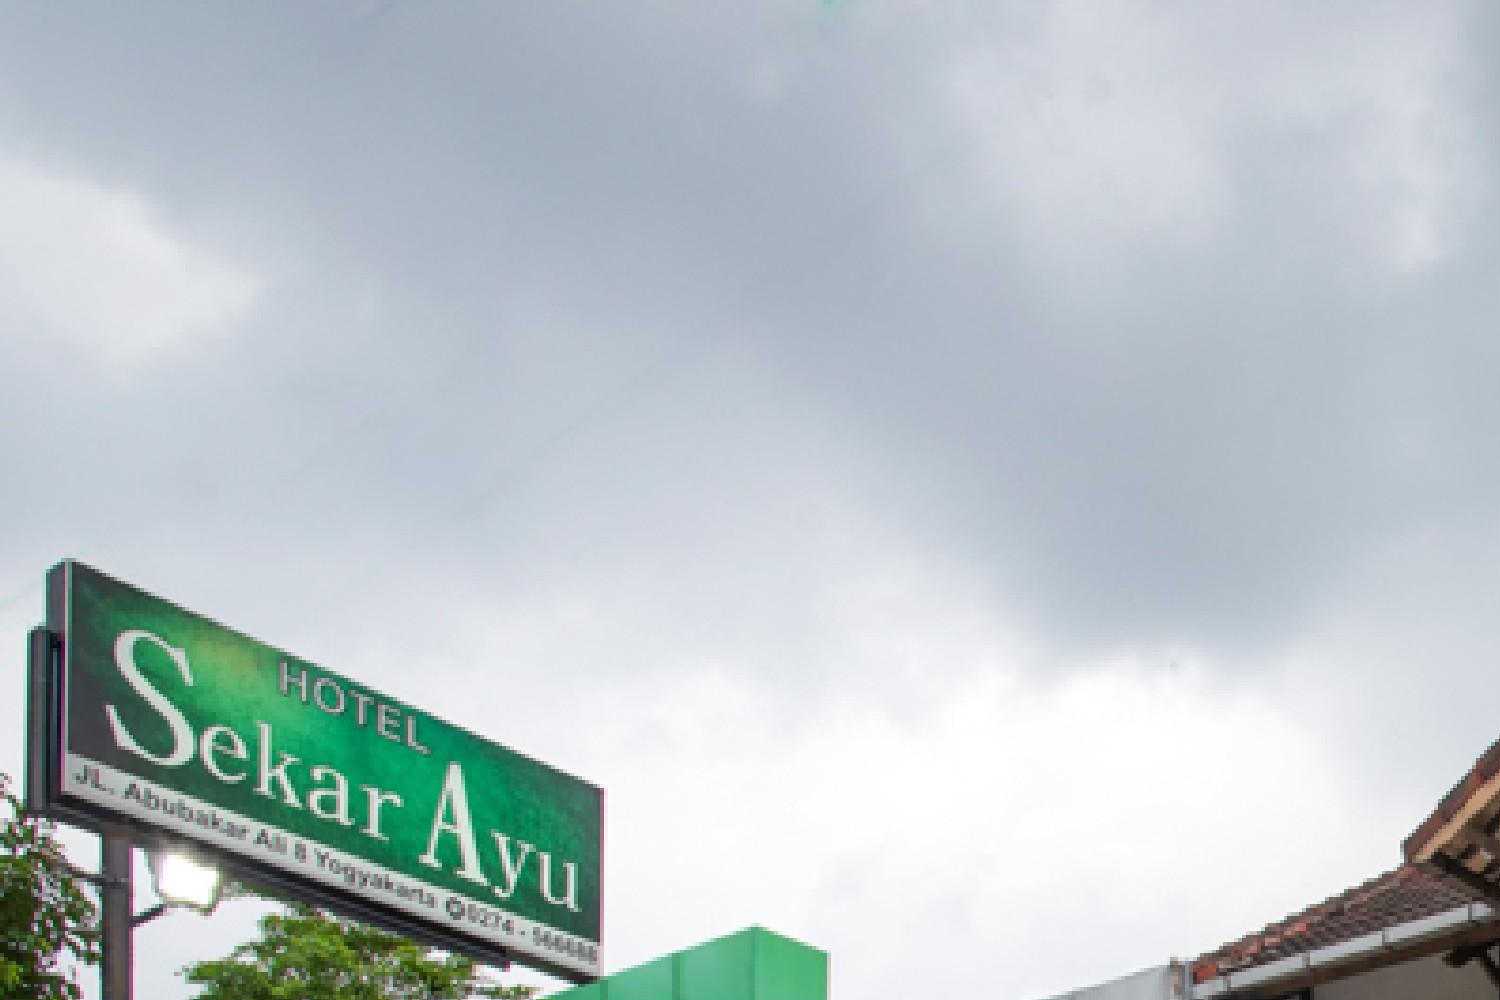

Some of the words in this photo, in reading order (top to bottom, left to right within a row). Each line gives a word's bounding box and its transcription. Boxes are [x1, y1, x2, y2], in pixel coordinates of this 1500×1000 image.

[279, 661, 432, 754] HOTEL
[105, 629, 404, 840] Sekar
[418, 760, 583, 914] Ayu
[124, 783, 248, 840] Abubakar
[255, 828, 288, 856] Ali
[314, 847, 437, 908] Yogyakarta
